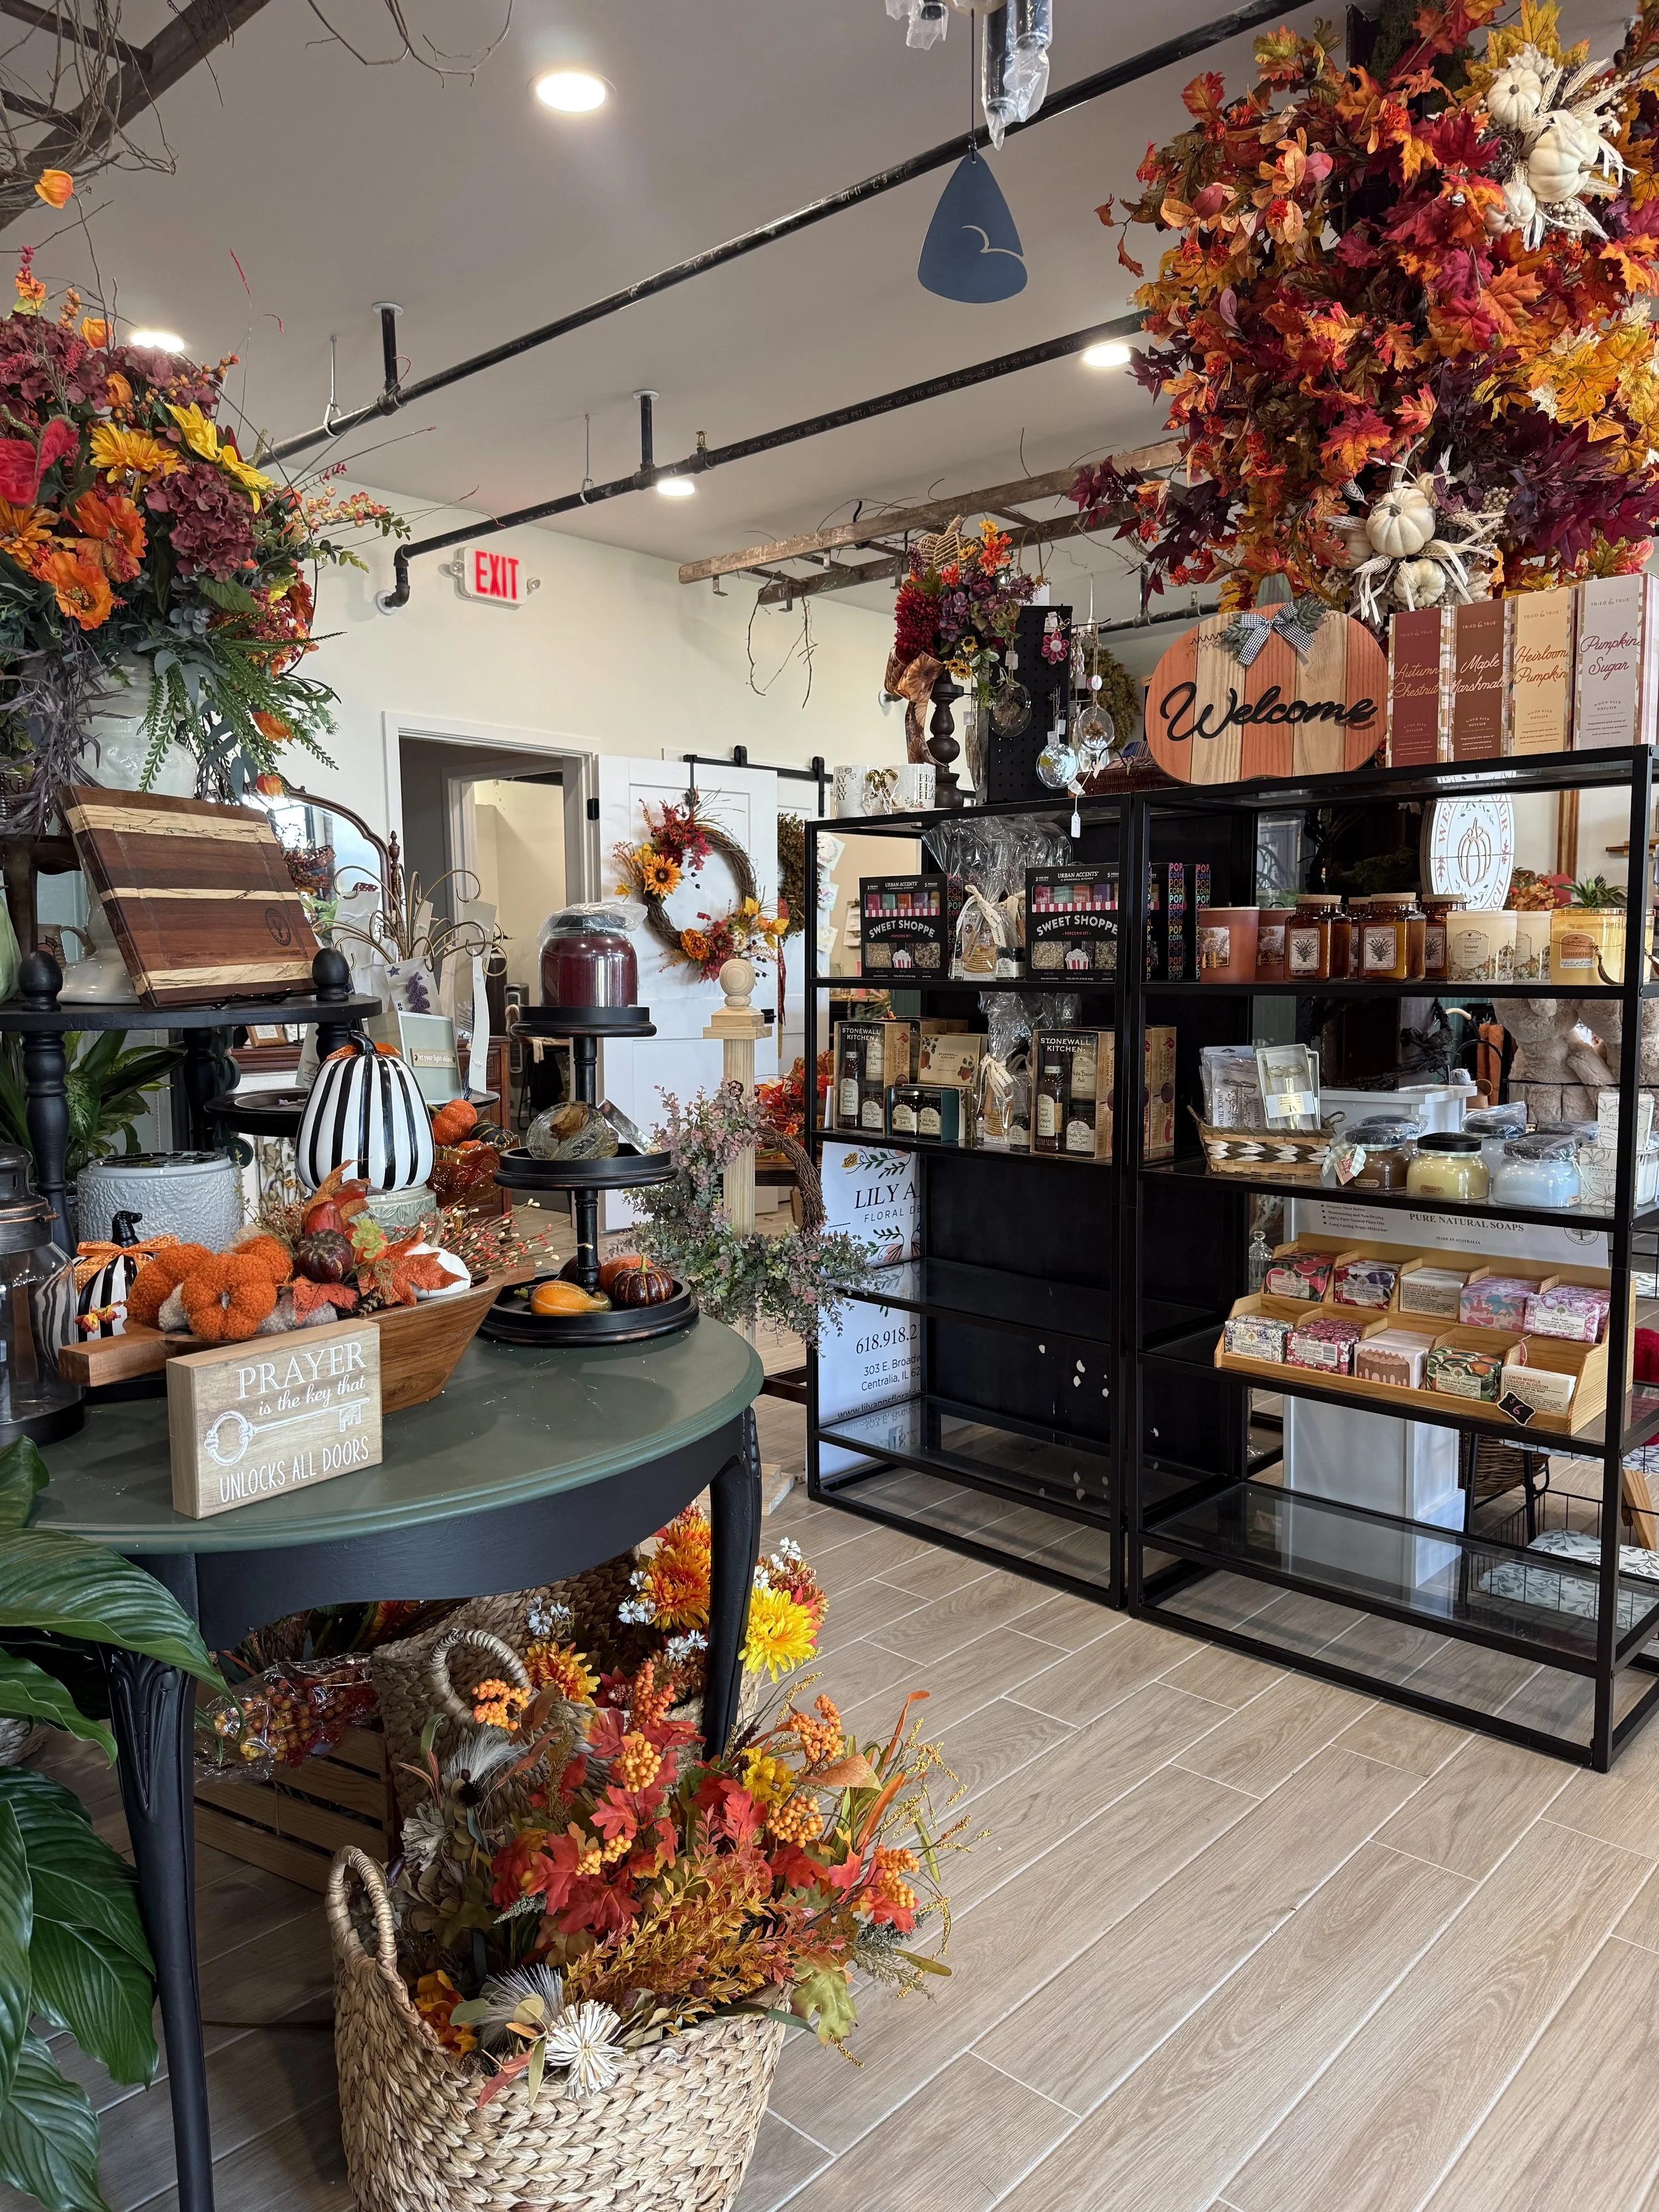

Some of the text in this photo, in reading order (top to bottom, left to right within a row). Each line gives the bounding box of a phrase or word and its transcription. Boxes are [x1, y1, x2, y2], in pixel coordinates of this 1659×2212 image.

[475, 550, 520, 600] EXIT
[1515, 644, 1569, 664] Heirloom
[1581, 632, 1640, 656] Pumpkin
[1394, 663, 1439, 681] Autumn
[1460, 653, 1500, 676] Maple
[1588, 656, 1629, 681] Sugar
[1514, 665, 1569, 688] Pumpkin
[1393, 682, 1439, 698] Chestnut
[1160, 681, 1378, 741] Welcome
[1169, 863, 1183, 871] POP
[1196, 864, 1210, 873] POP
[1169, 879, 1183, 888] POP
[1196, 879, 1210, 889] POP
[1169, 895, 1183, 903] POP
[1196, 895, 1210, 903] POP
[1169, 910, 1183, 919] POP
[869, 919, 936, 939] SWEET SHOPPE
[1037, 915, 1118, 936] SWEET SHOPPE
[1169, 926, 1182, 934] POP
[1169, 941, 1182, 950] POP
[433, 1054, 442, 1063] light
[854, 1181, 920, 1209] LILY A
[865, 1205, 920, 1222] FLORAL DE
[1409, 1213, 1524, 1232] PURE NATURAL SOAPS
[856, 1323, 920, 1355] 618.918.2
[236, 1341, 366, 1400] PRAYER
[864, 1354, 920, 1376] 303 E. Broadw
[861, 1374, 900, 1391] Centralia,
[902, 1370, 909, 1380] IL
[259, 1374, 366, 1416] is the key that
[220, 1436, 368, 1503] UNLOCKS ALL DOORS
